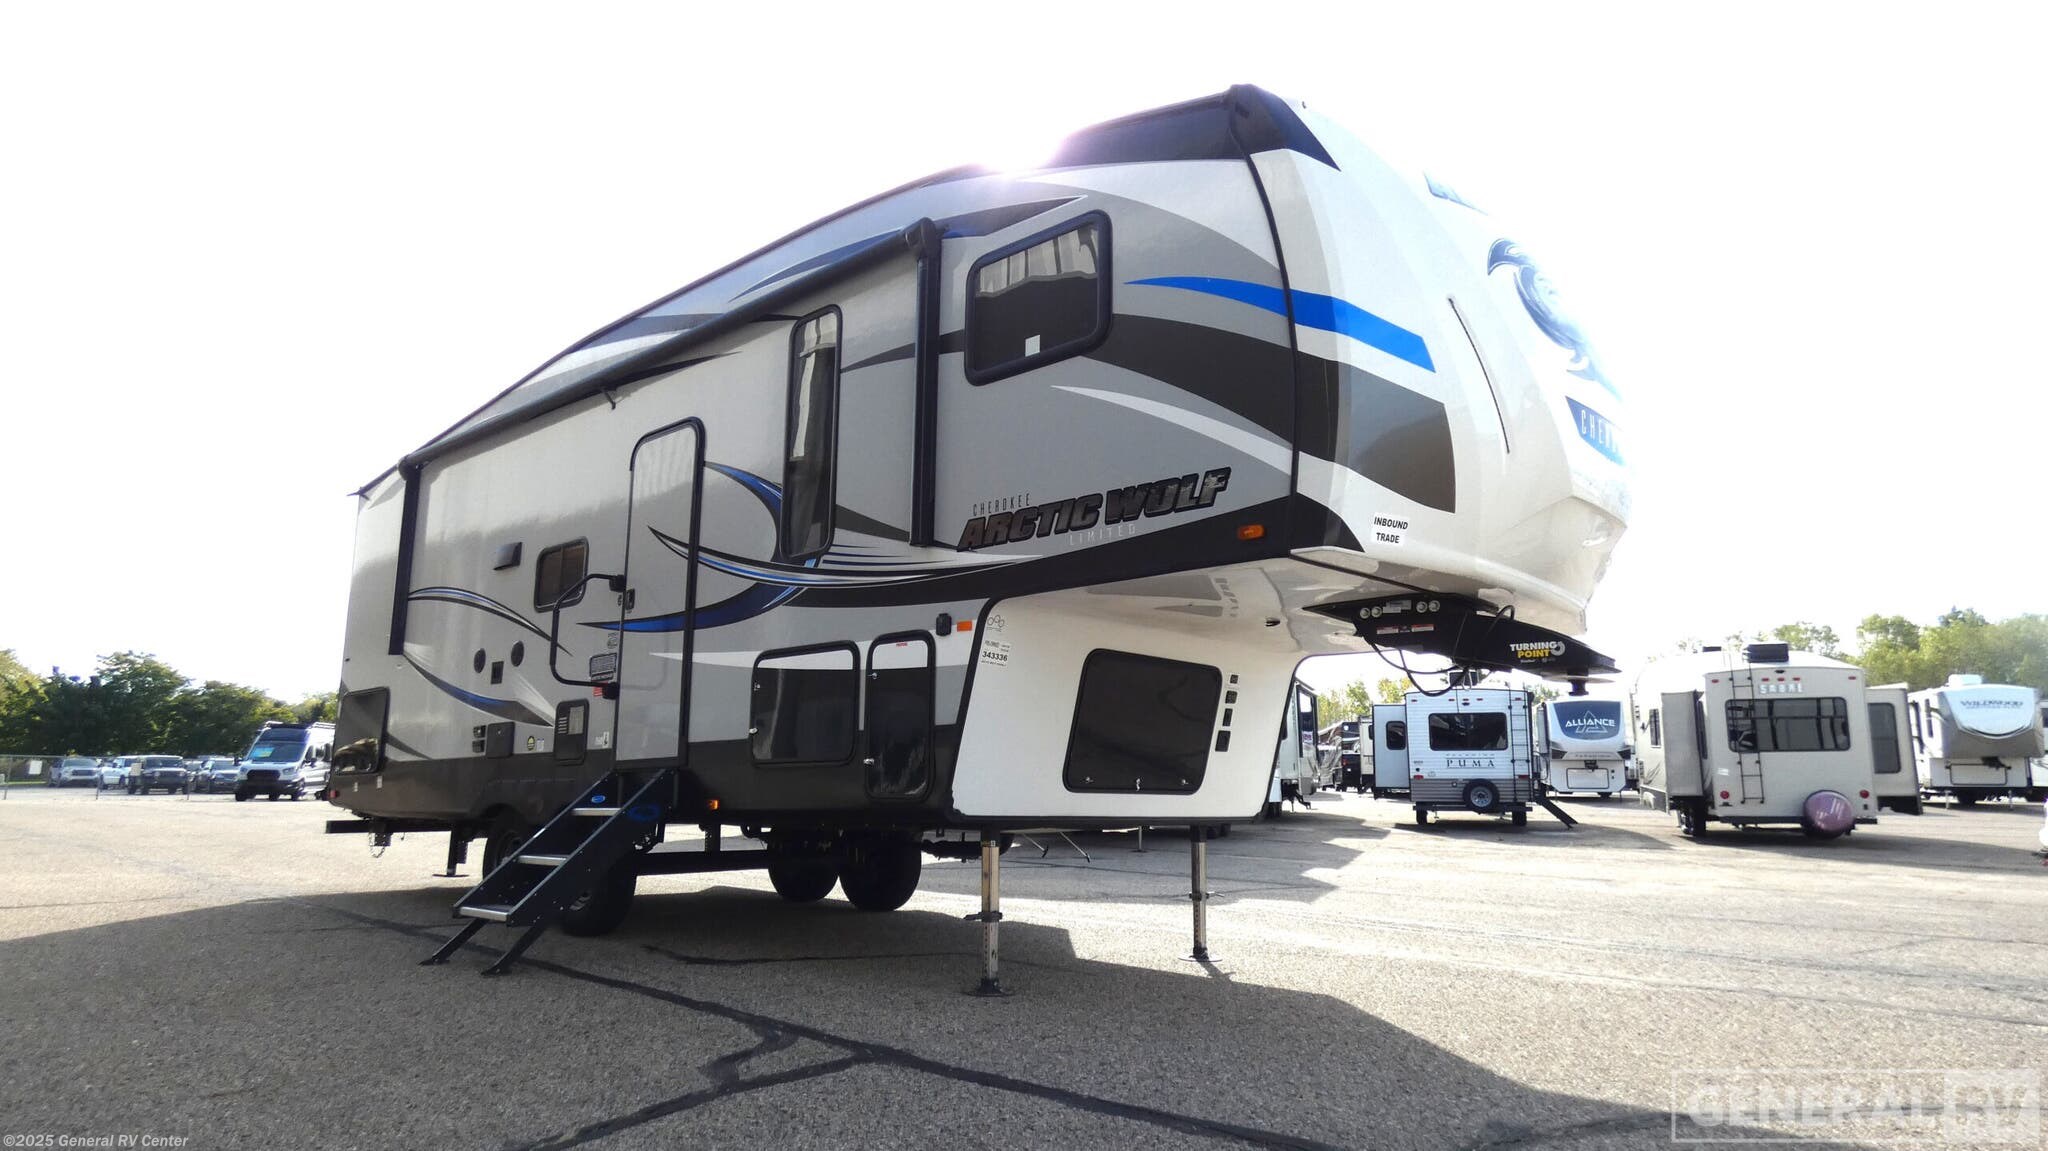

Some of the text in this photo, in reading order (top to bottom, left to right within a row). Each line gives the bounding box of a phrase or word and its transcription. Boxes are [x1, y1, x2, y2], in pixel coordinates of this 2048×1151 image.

[956, 466, 1232, 553] ARCTIC WOLF
[972, 492, 1031, 517] CHEROKEE
[1373, 516, 1409, 530] INBOUND
[1068, 524, 1136, 546] LIMITED
[1376, 532, 1400, 544] TRADE
[1510, 641, 1558, 652] TURNING
[982, 650, 1008, 662] 343336
[1517, 649, 1551, 659] POINT
[1565, 718, 1616, 728] ALLIANCE
[1446, 759, 1495, 767] PUMA
